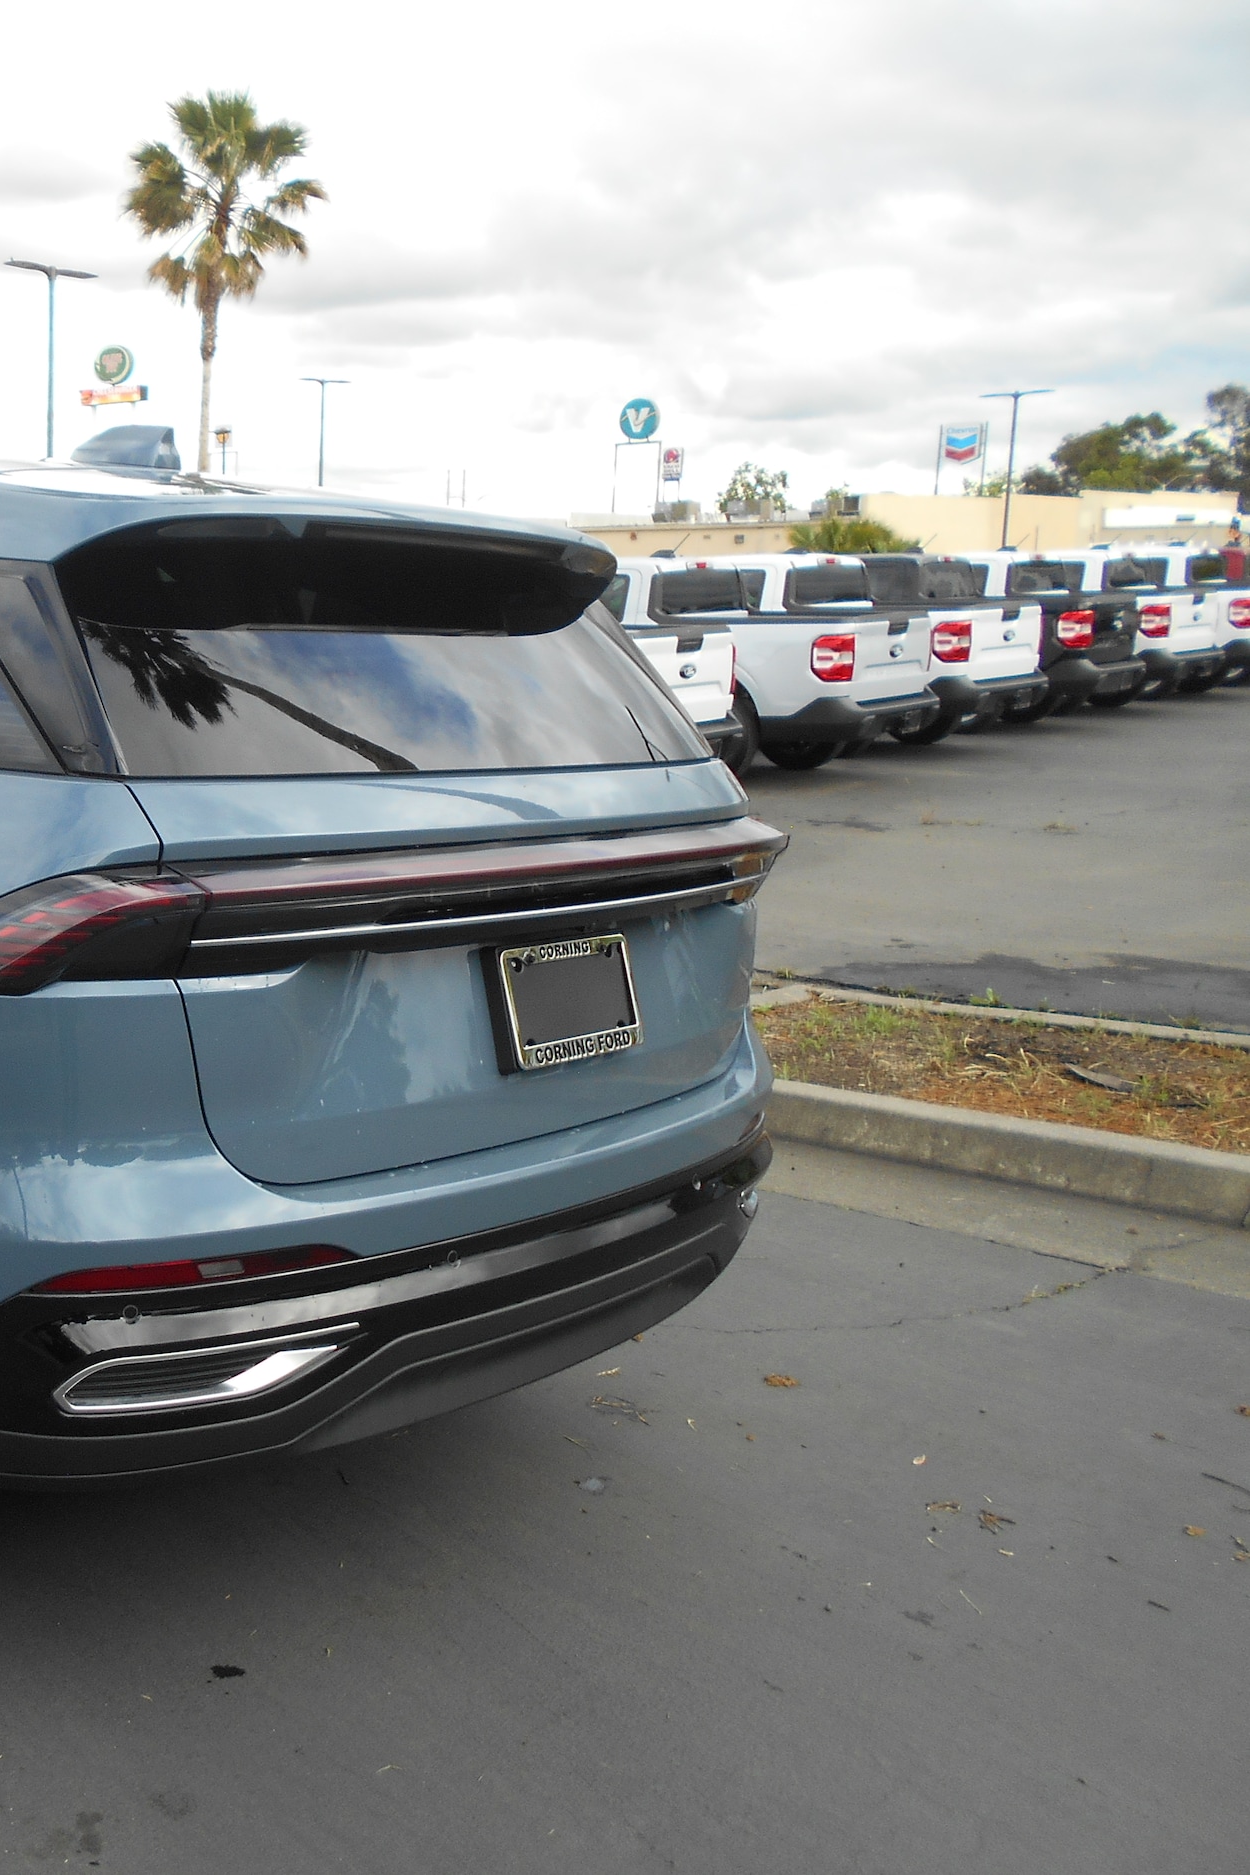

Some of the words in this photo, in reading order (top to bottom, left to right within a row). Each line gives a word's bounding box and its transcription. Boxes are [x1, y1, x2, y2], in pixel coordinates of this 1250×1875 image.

[539, 941, 591, 960] CORNING
[535, 1038, 595, 1064] CORNING
[597, 1030, 632, 1051] FORD
